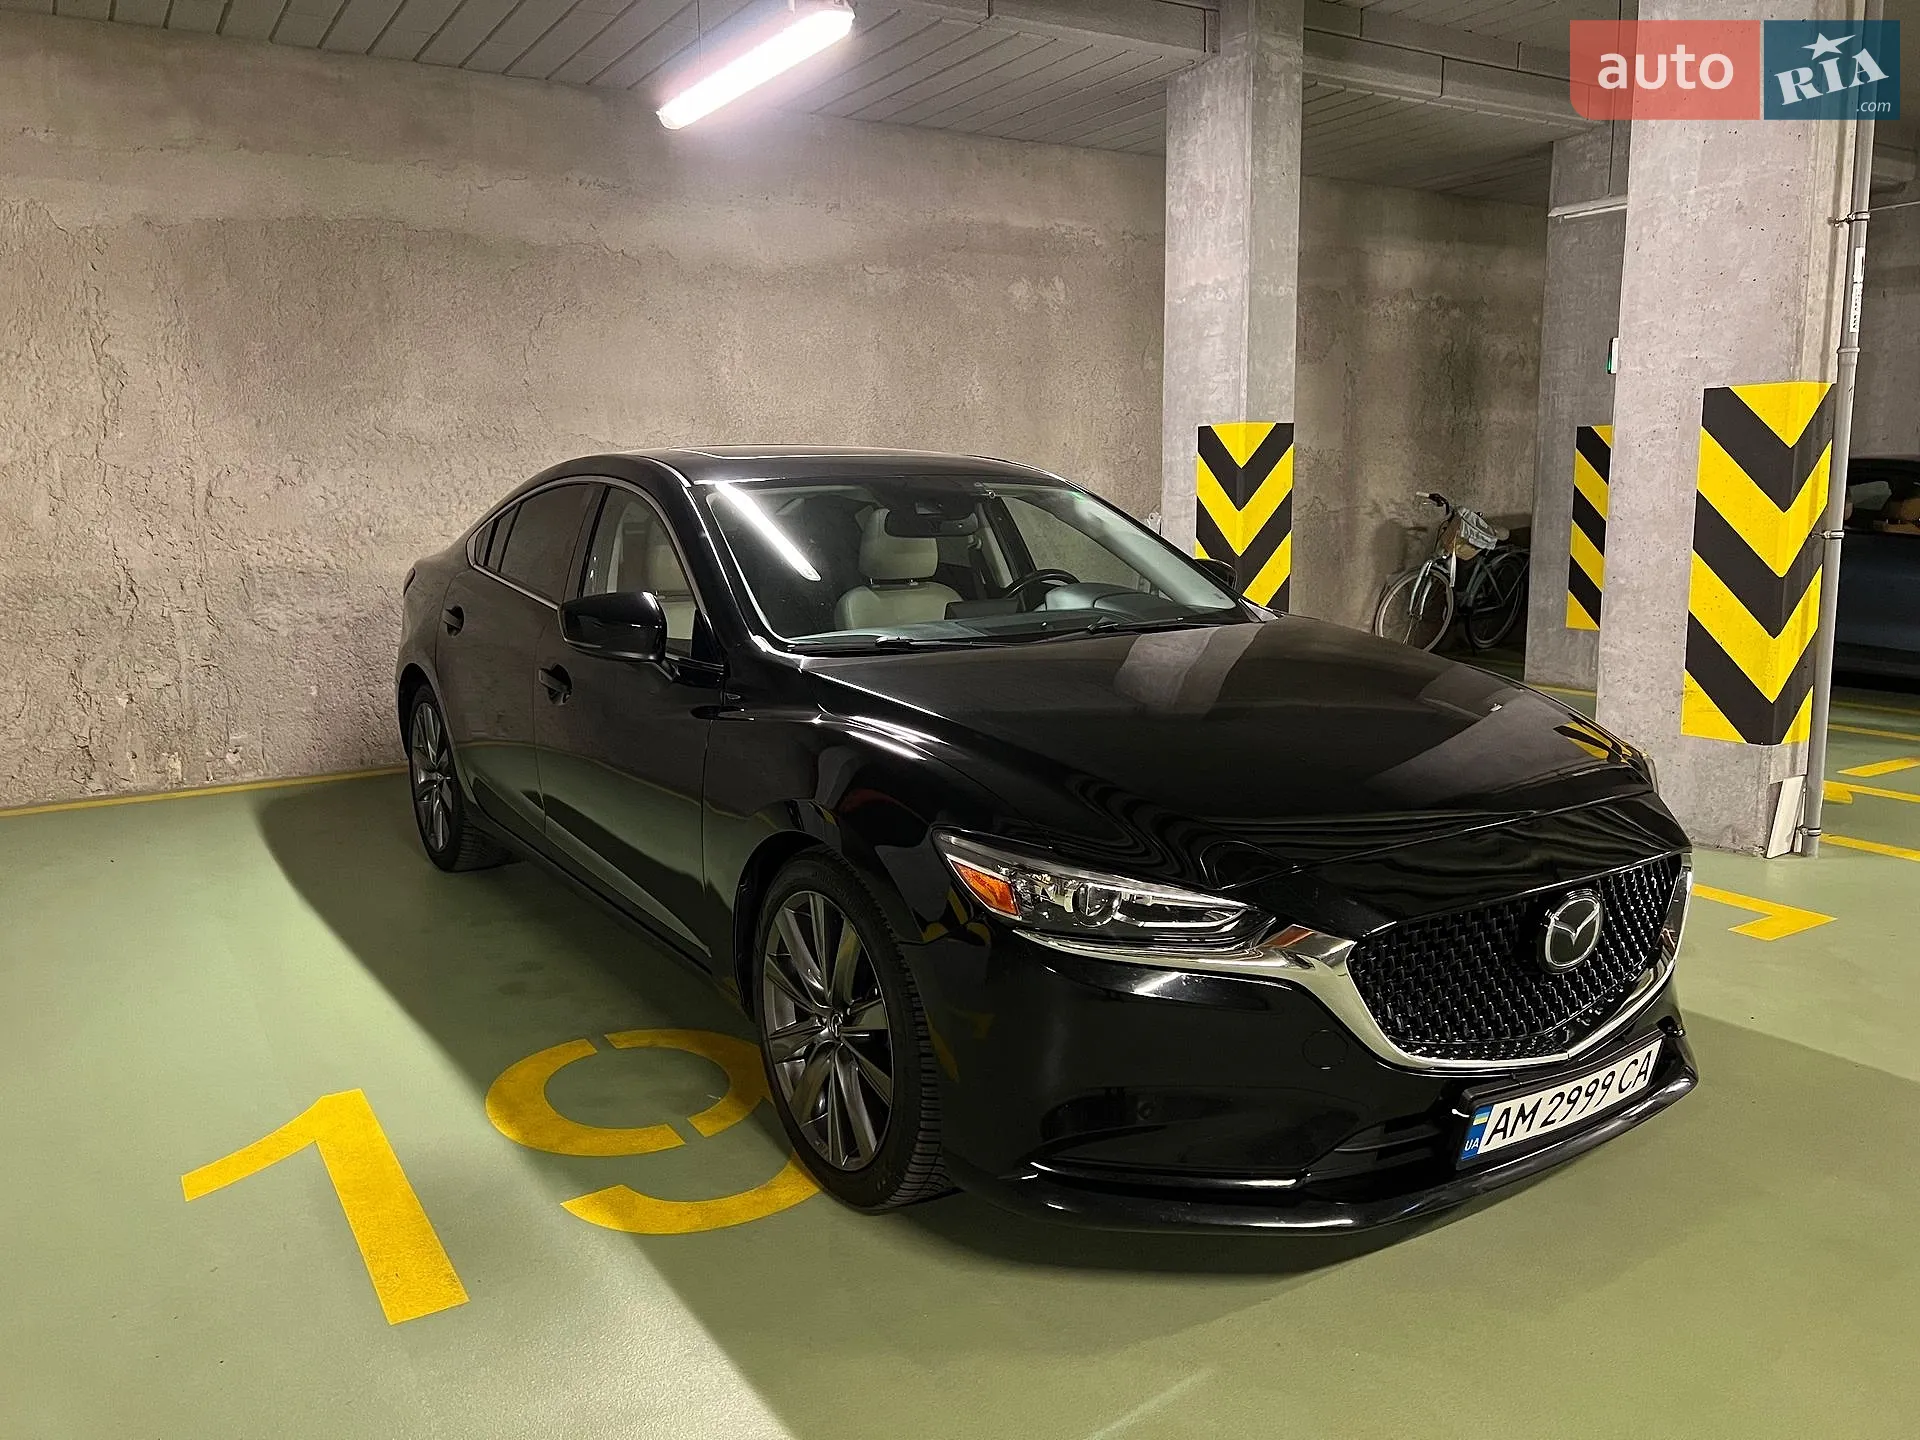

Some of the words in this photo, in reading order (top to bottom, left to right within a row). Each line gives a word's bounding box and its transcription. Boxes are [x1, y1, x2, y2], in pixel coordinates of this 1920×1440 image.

[1464, 1139, 1480, 1151] UA
[1484, 1097, 1543, 1146] AM
[1539, 1070, 1616, 1129] 2999
[1617, 1050, 1654, 1094] CA
[181, 1028, 821, 1325] 19
